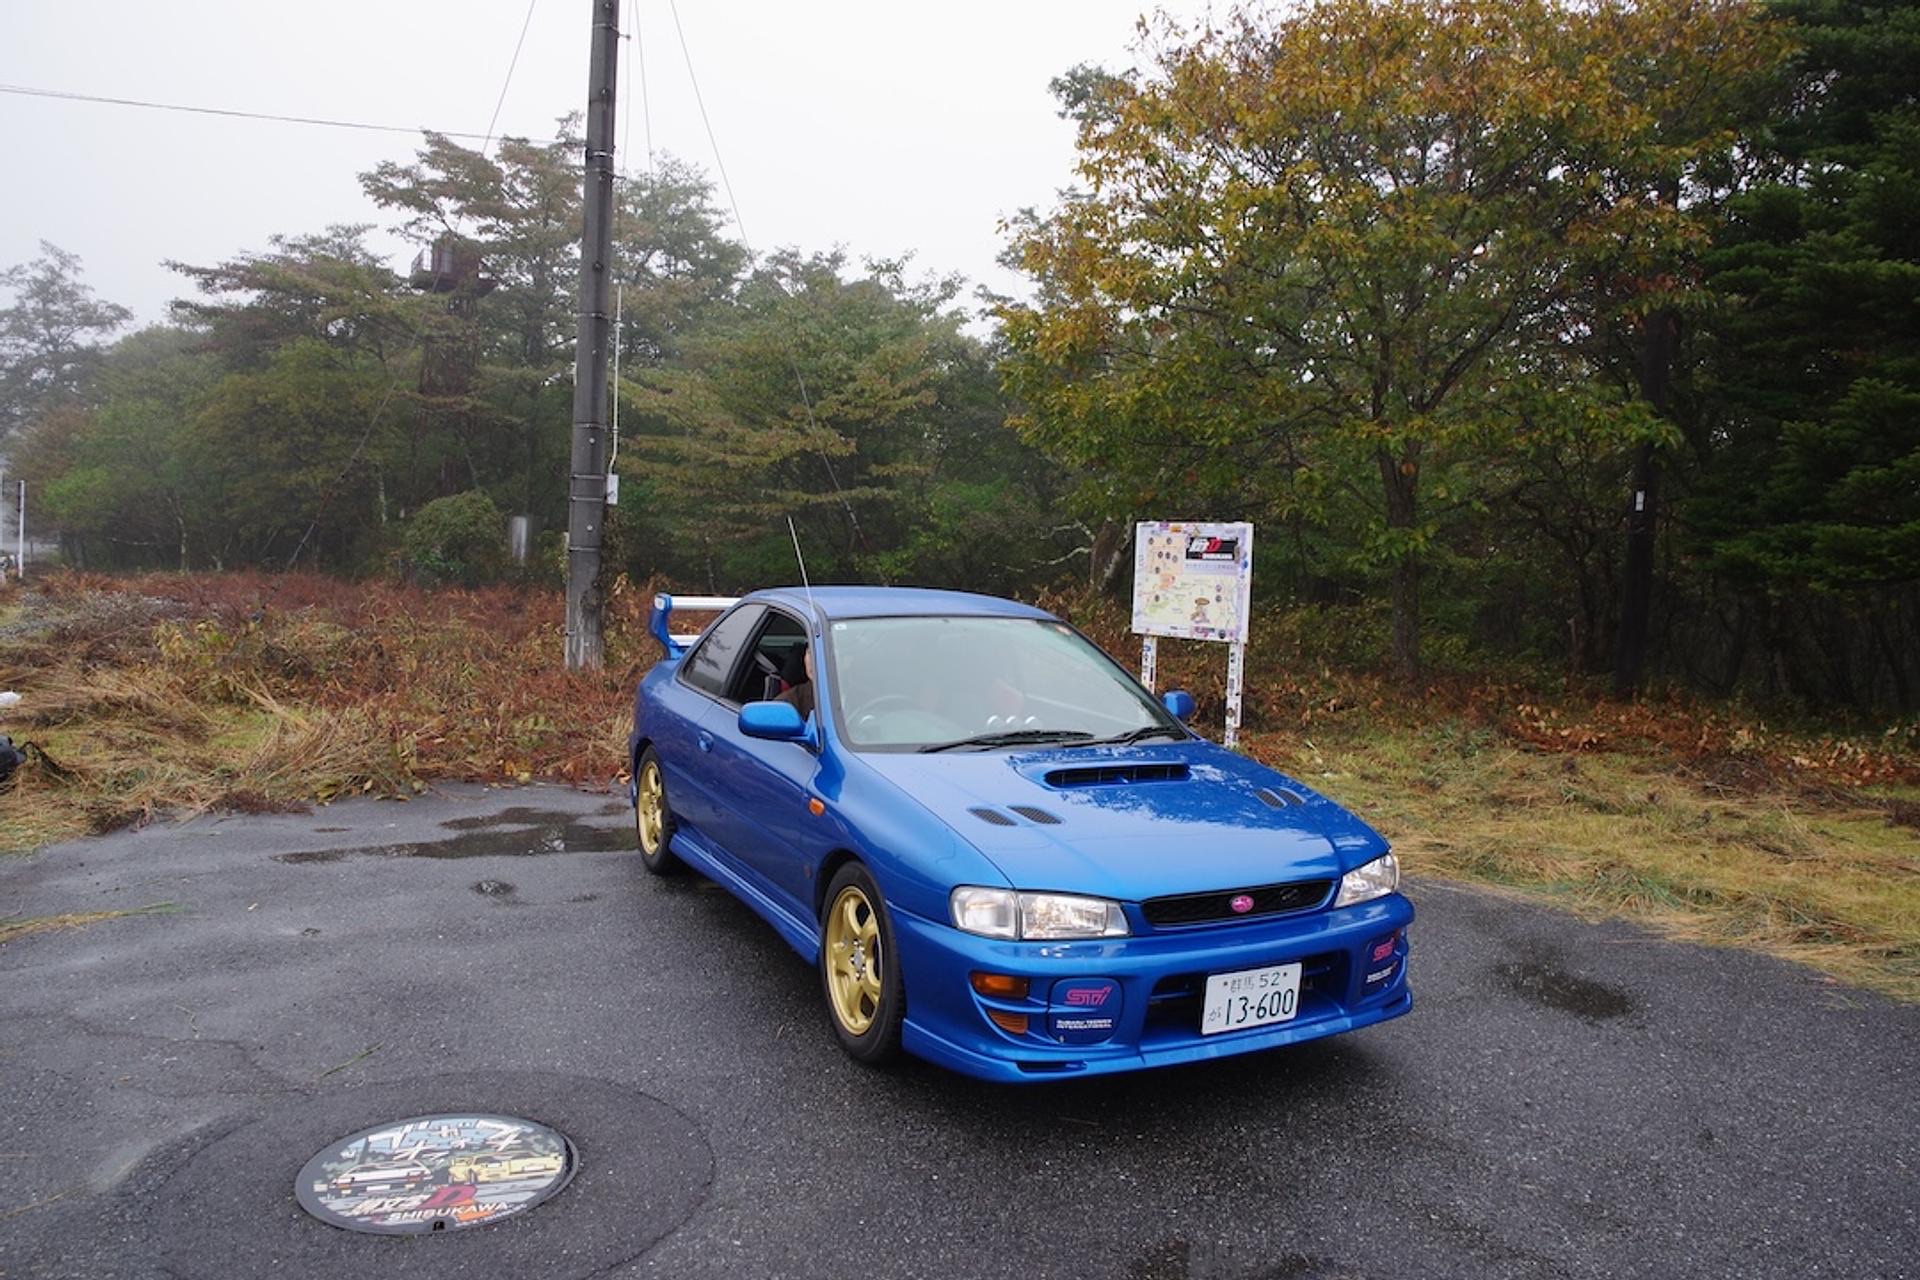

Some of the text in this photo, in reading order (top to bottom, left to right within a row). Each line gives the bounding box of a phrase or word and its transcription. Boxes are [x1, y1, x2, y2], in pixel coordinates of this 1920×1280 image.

[1259, 971, 1280, 988] 52
[1225, 988, 1294, 1025] 13-600
[389, 1202, 508, 1219] SHIBUKAWA
